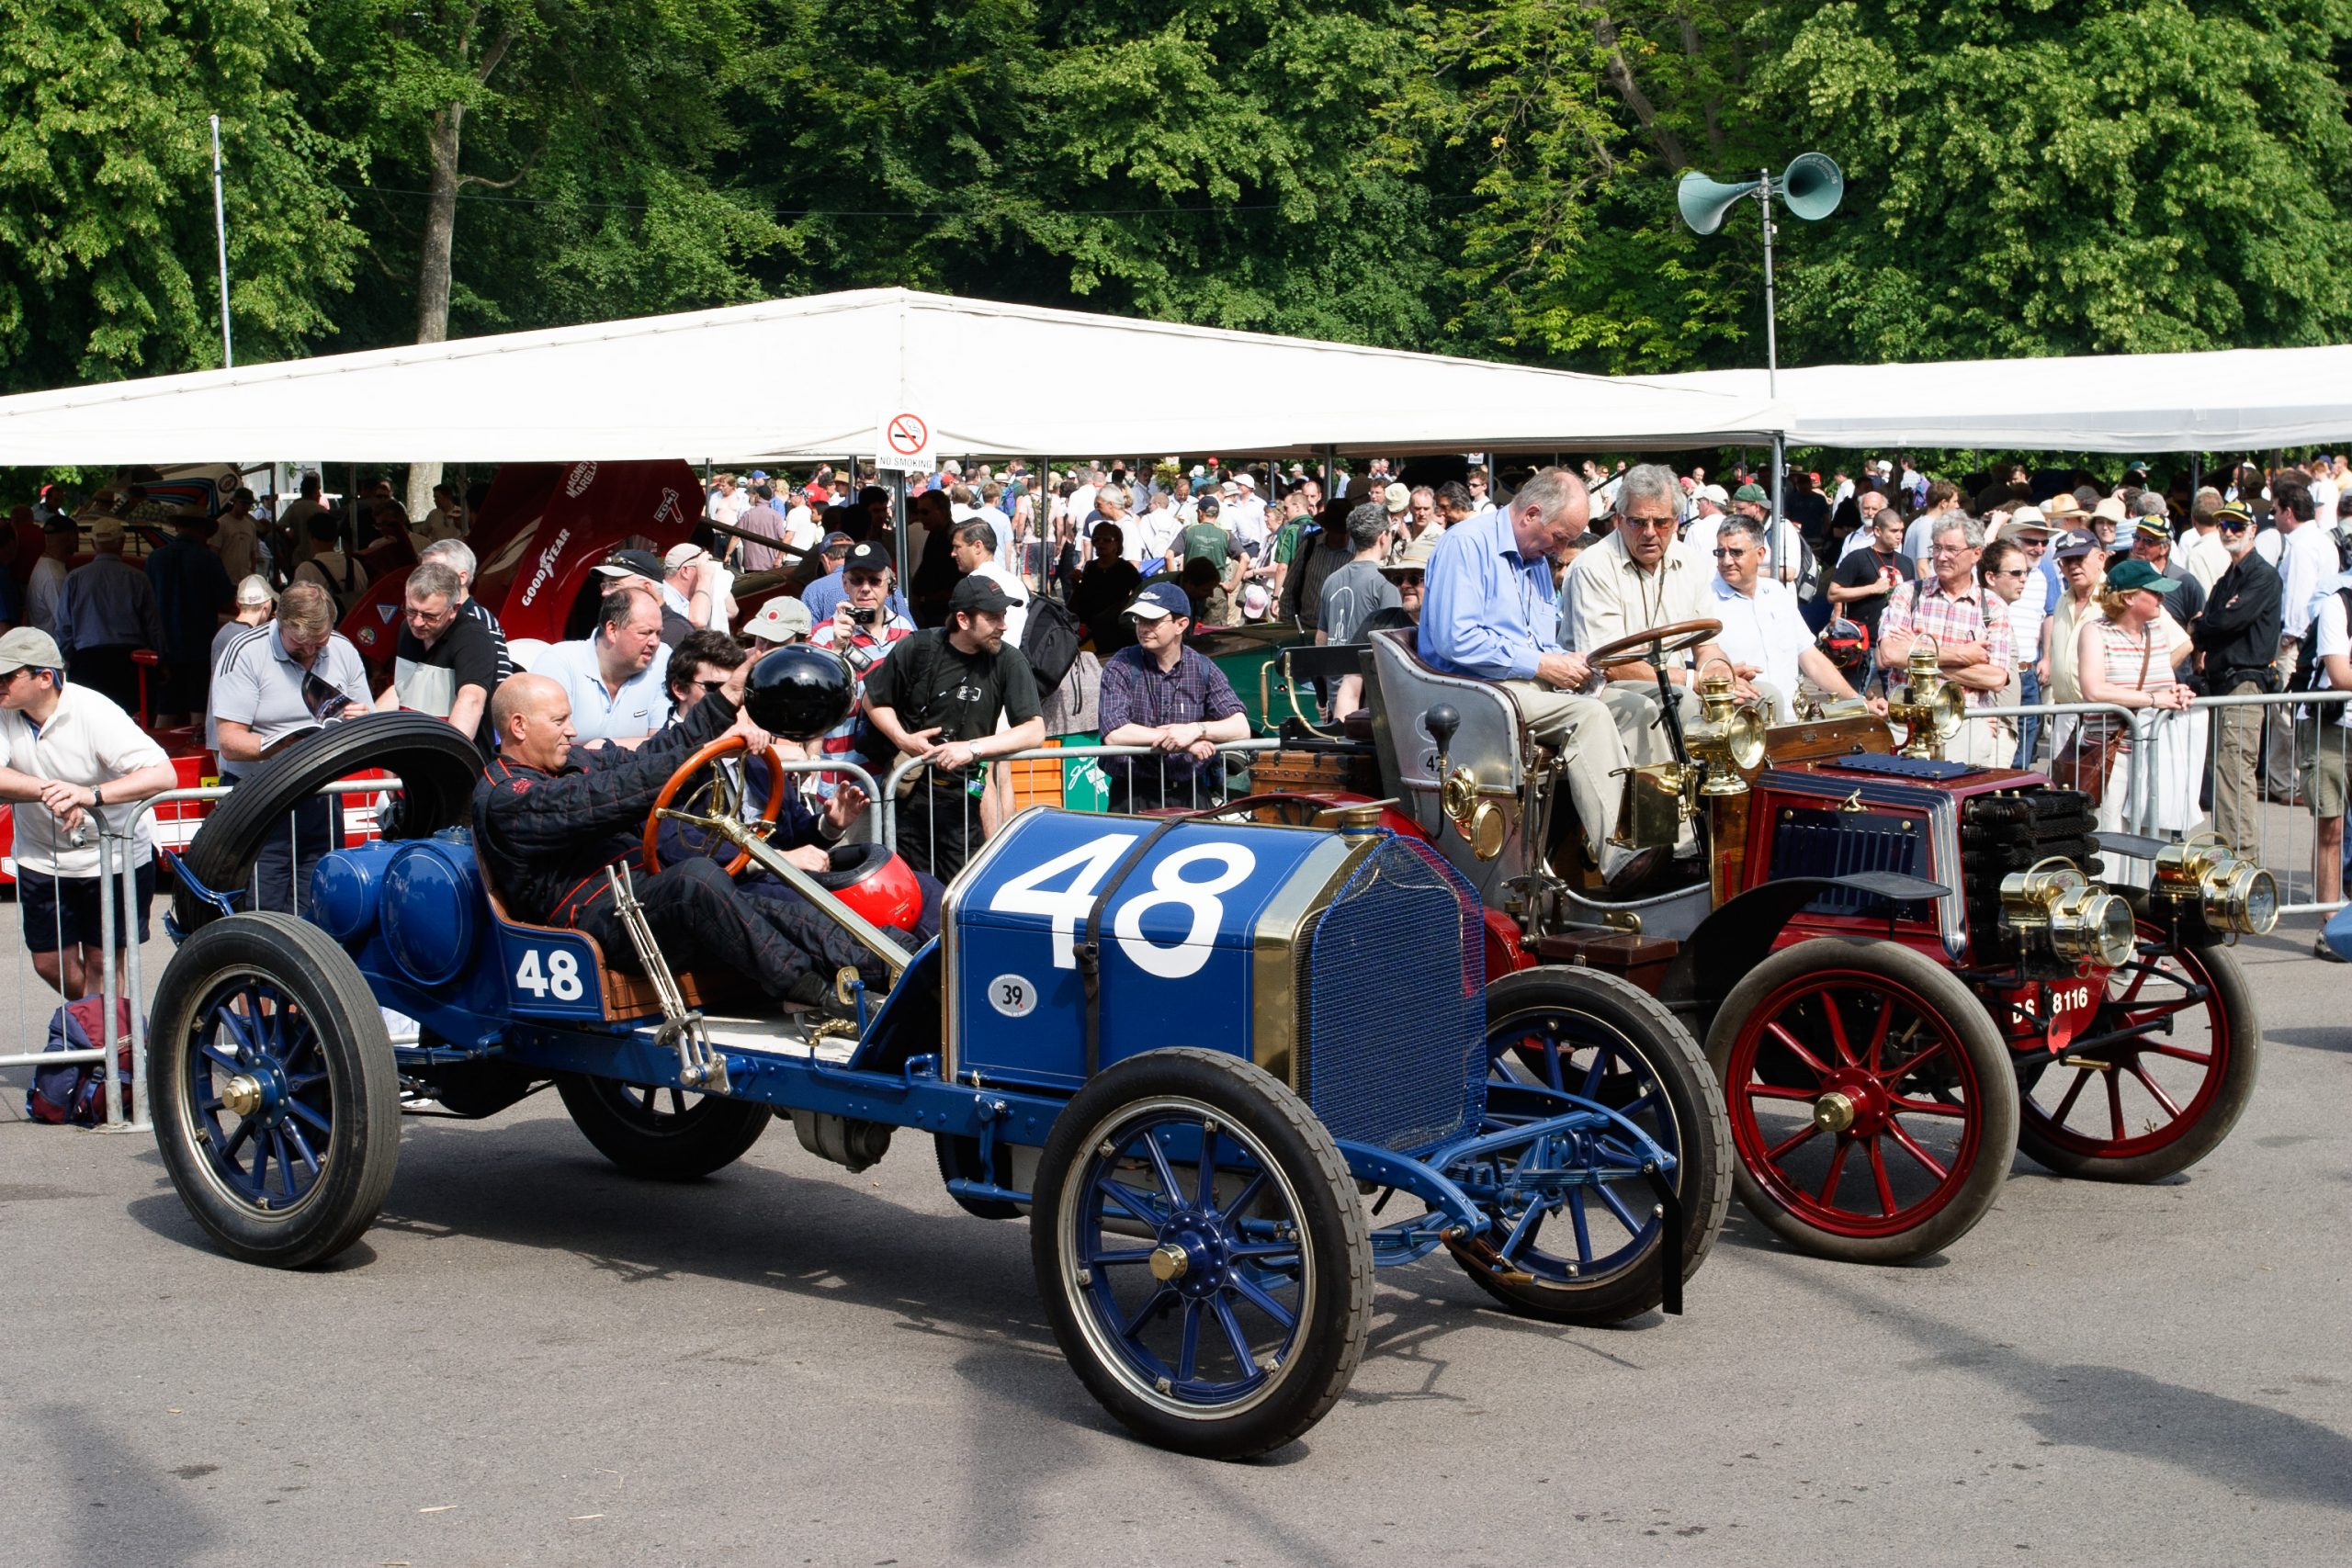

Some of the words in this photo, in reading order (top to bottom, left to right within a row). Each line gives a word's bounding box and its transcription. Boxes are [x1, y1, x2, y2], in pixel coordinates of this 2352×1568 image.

[880, 457, 891, 466] NO
[894, 457, 932, 468] SMOKING
[657, 491, 677, 520] KONI
[522, 528, 571, 606] GOODYEAR
[989, 833, 1256, 979] 48
[515, 950, 583, 1000] 48
[1002, 985, 1023, 1005] 39
[2052, 987, 2088, 1013] 8116
